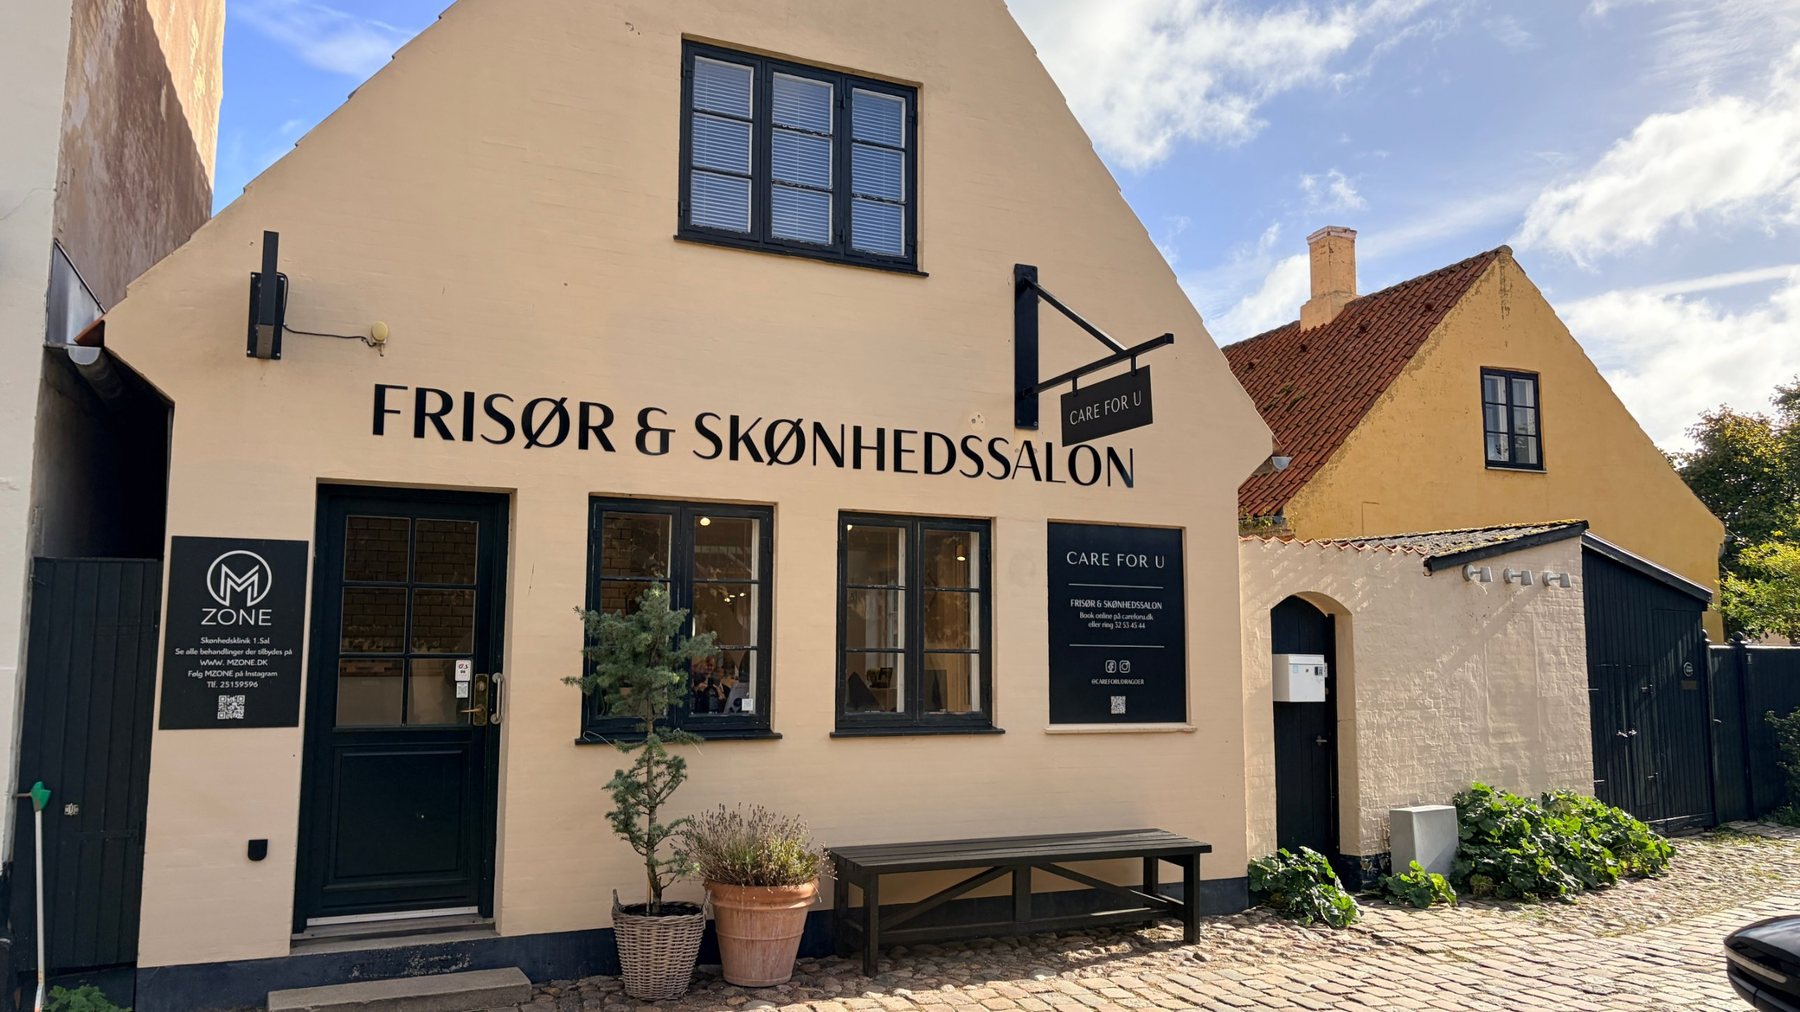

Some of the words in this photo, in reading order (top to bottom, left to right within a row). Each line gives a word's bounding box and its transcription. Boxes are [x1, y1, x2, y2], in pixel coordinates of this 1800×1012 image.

[1070, 403, 1100, 425] CARE
[1104, 395, 1129, 416] FOR
[1133, 390, 1142, 406] U
[372, 383, 616, 452] FRISØR
[635, 406, 676, 456] &
[693, 412, 1134, 489] SKØNHEDSSALON
[1066, 551, 1110, 566] CARE
[1117, 553, 1149, 568] FOR
[1155, 556, 1164, 568] U
[1071, 599, 1095, 608] FRISØR
[1104, 600, 1162, 609] SKØNHEDSSALON
[201, 608, 272, 626] ZONE
[1095, 612, 1112, 620] online
[1114, 612, 1121, 621] på
[200, 648, 244, 656] behandlinger
[284, 648, 292, 656] på
[188, 670, 203, 678] Følg
[235, 670, 244, 678] på
